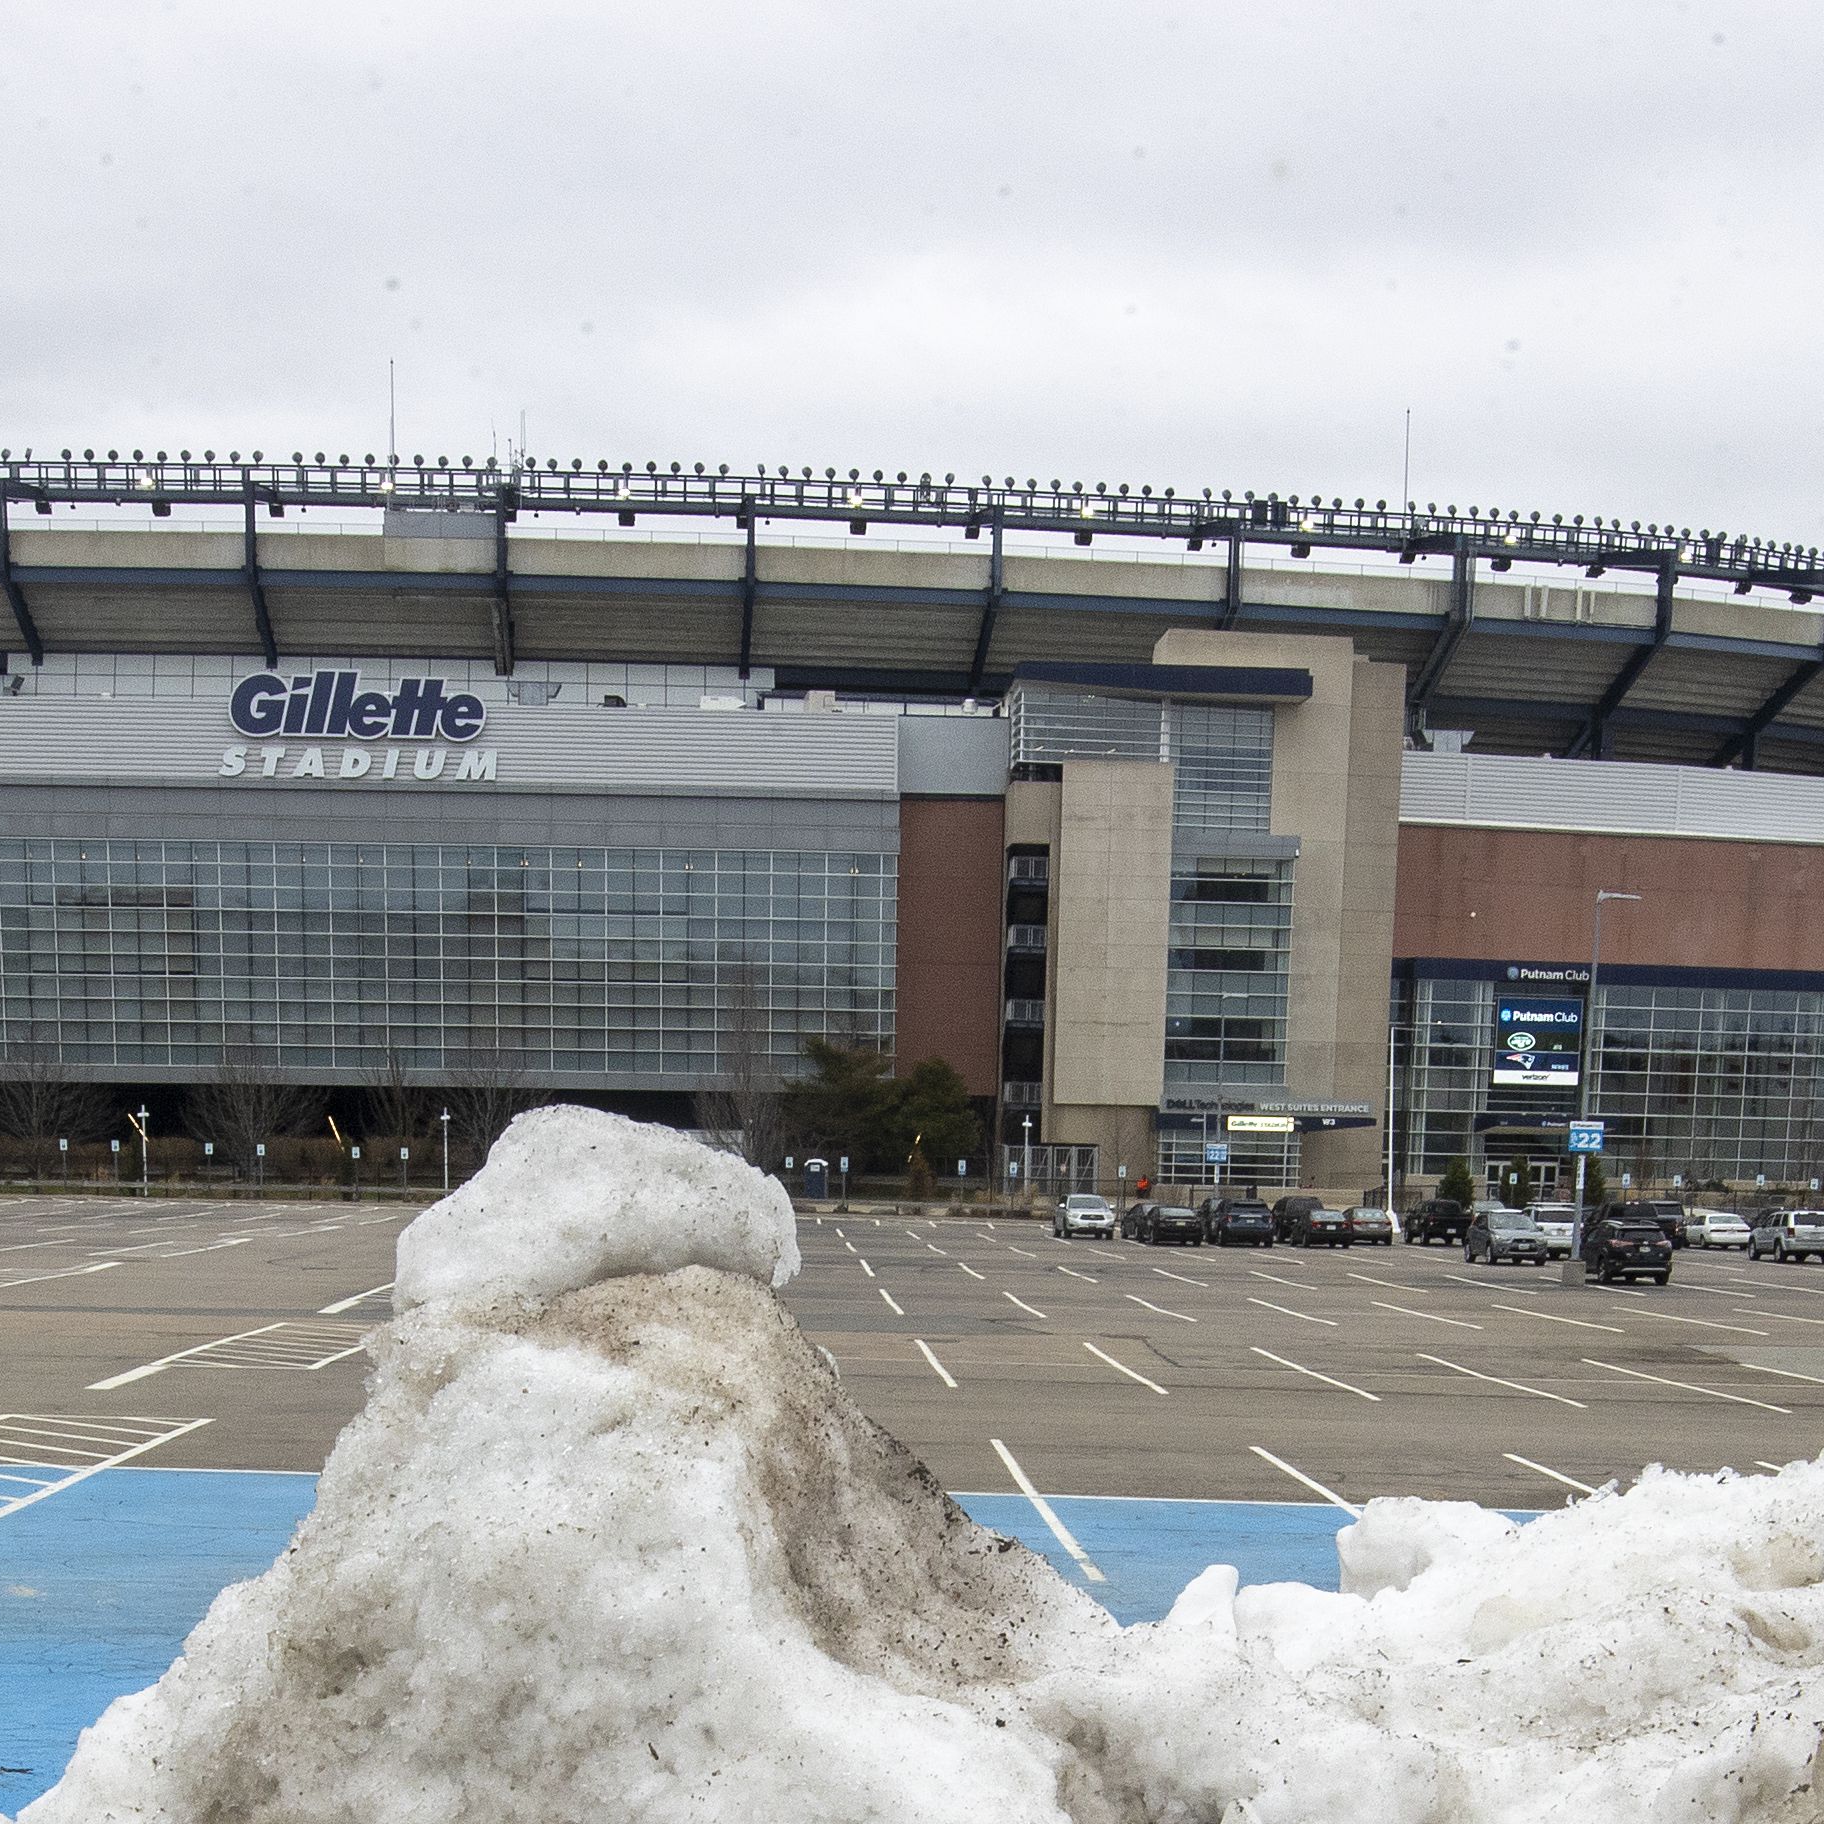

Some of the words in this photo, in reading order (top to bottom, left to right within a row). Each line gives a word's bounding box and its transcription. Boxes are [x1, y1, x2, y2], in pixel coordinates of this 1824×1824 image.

[230, 669, 487, 742] Gillette
[219, 746, 498, 782] STADIUM
[1520, 968, 1564, 980] Putnam
[1565, 970, 1590, 981] Club
[1513, 1011, 1554, 1022] Putnam
[1554, 1011, 1578, 1023] Club
[1259, 1102, 1286, 1112] WEST
[1287, 1103, 1319, 1113] SUITES
[1320, 1104, 1369, 1113] ENTRANCE
[1577, 1133, 1602, 1149] 22
